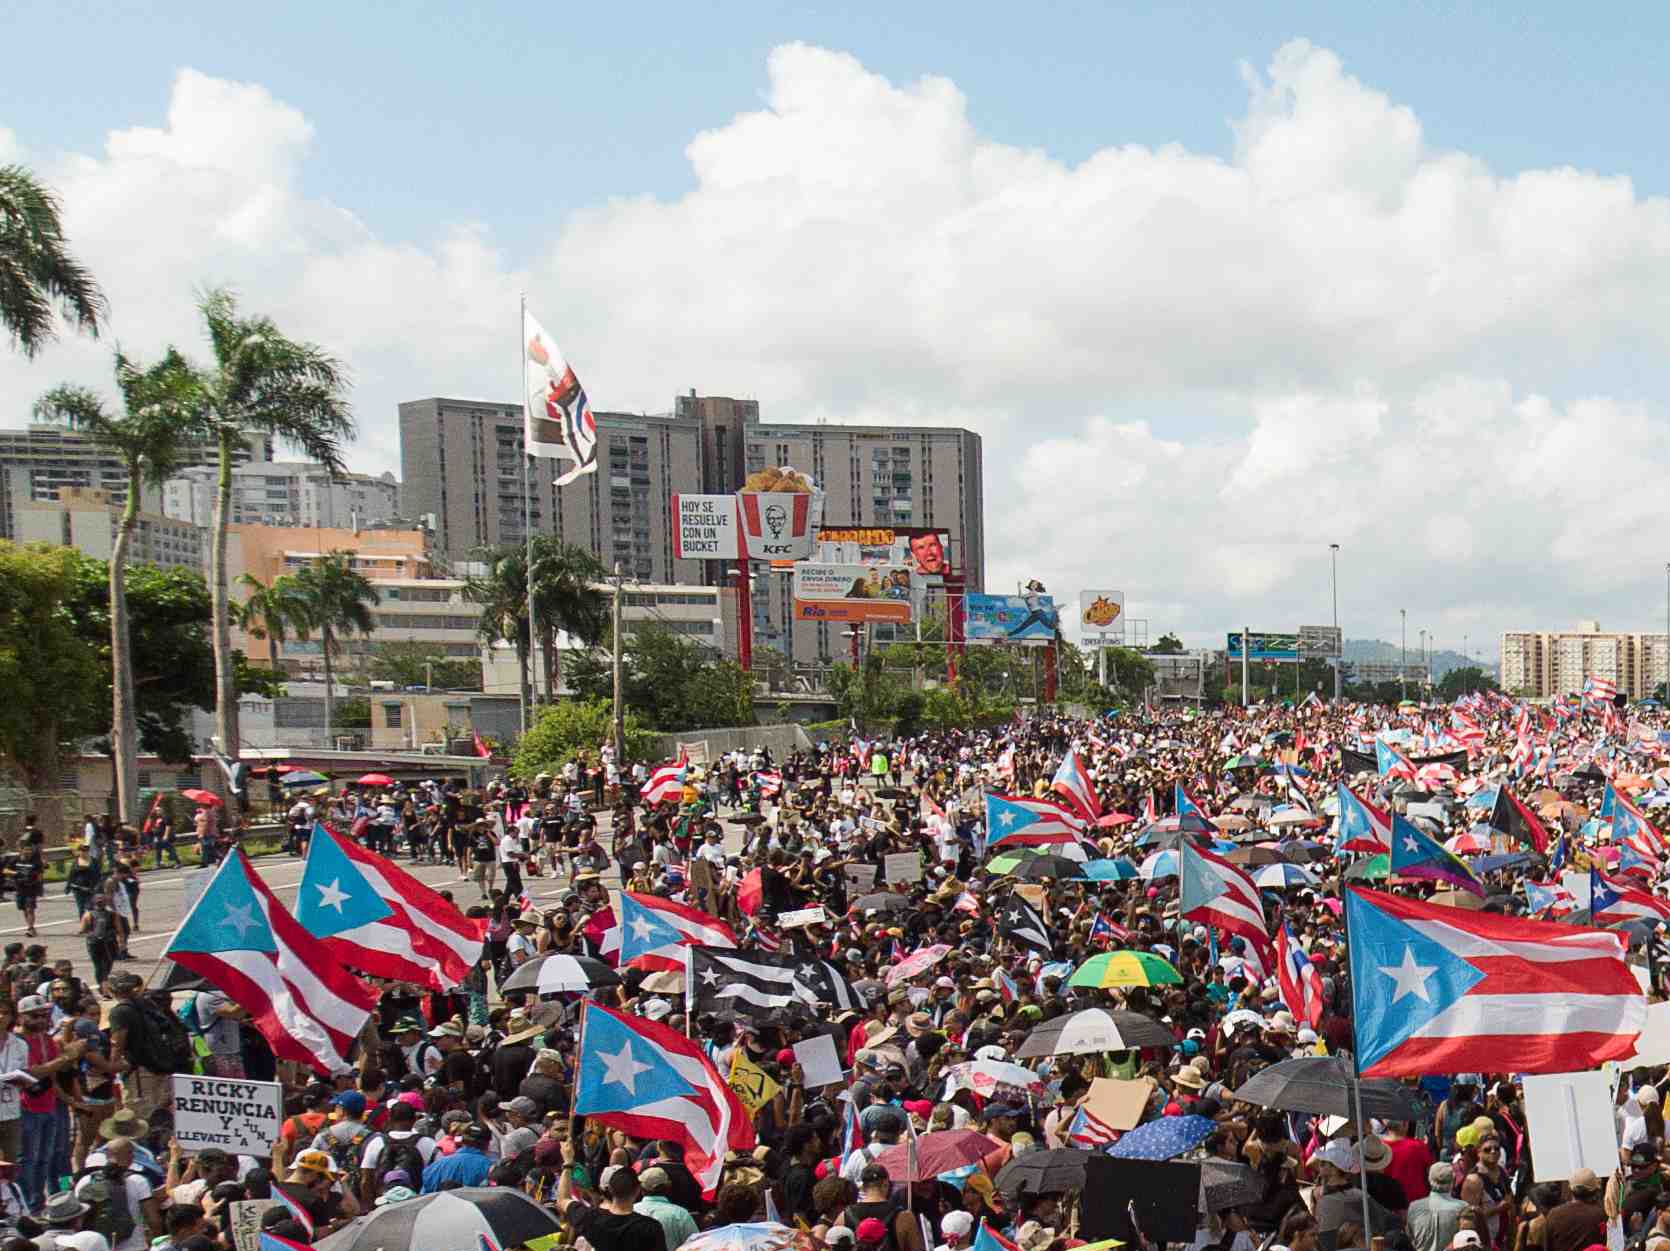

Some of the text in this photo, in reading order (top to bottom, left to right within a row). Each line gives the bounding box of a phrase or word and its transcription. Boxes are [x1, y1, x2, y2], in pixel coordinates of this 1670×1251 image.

[681, 501, 713, 513] HOY SE
[681, 514, 729, 527] RESUELVE
[682, 527, 717, 540] CON UN
[683, 540, 719, 552] BUCKET
[763, 544, 793, 555] KFC
[192, 1081, 258, 1100] RICKY
[175, 1097, 276, 1120] RENUNCIA
[219, 1116, 233, 1130] Y
[176, 1130, 231, 1144] LLEVATE
